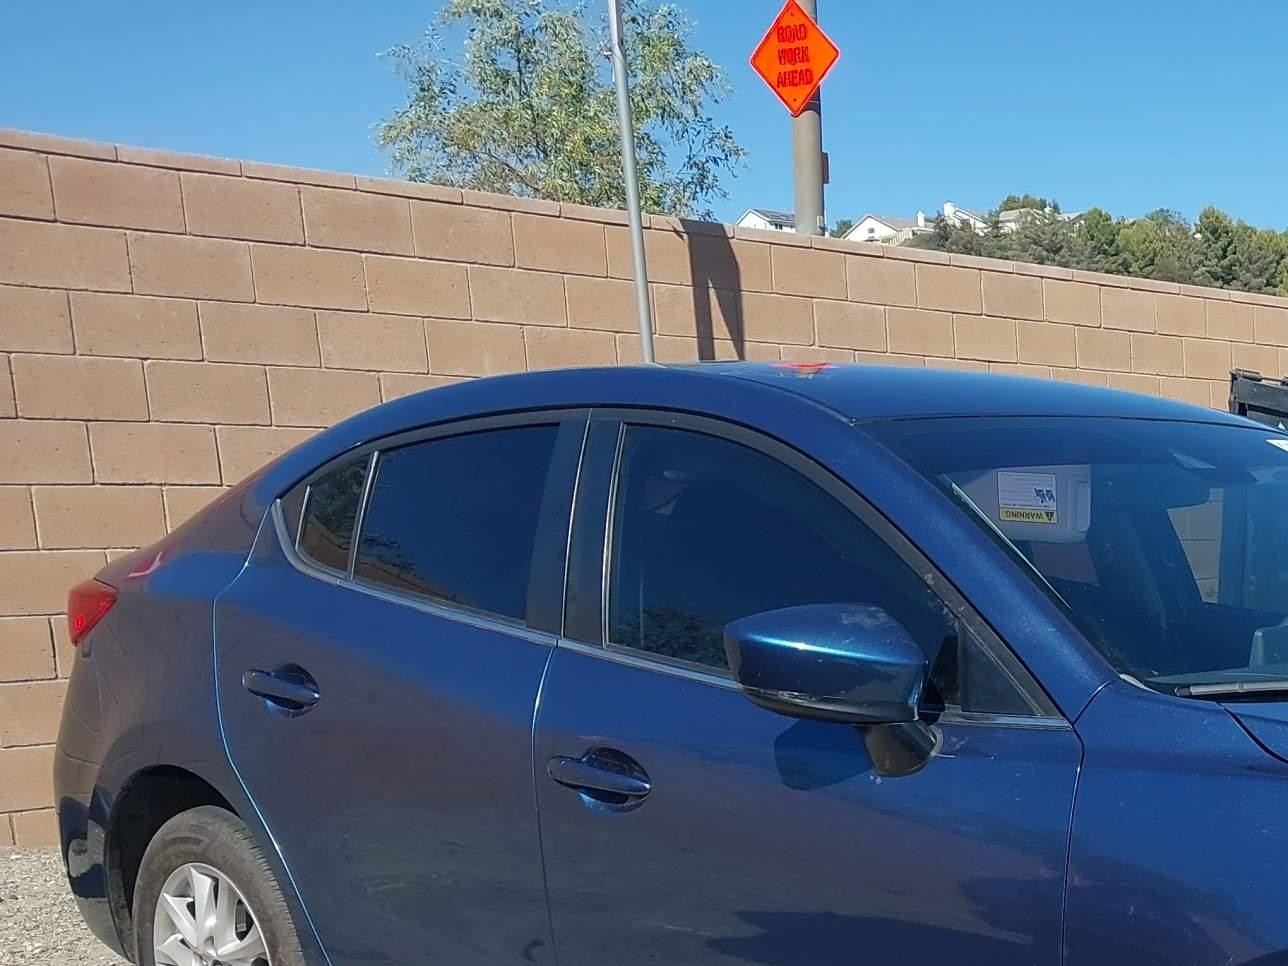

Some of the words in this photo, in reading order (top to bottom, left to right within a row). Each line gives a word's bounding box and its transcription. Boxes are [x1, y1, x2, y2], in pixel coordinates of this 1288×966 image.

[776, 24, 808, 43] ROAD
[776, 68, 814, 88] AHEAD
[1005, 510, 1044, 520] WARNING
